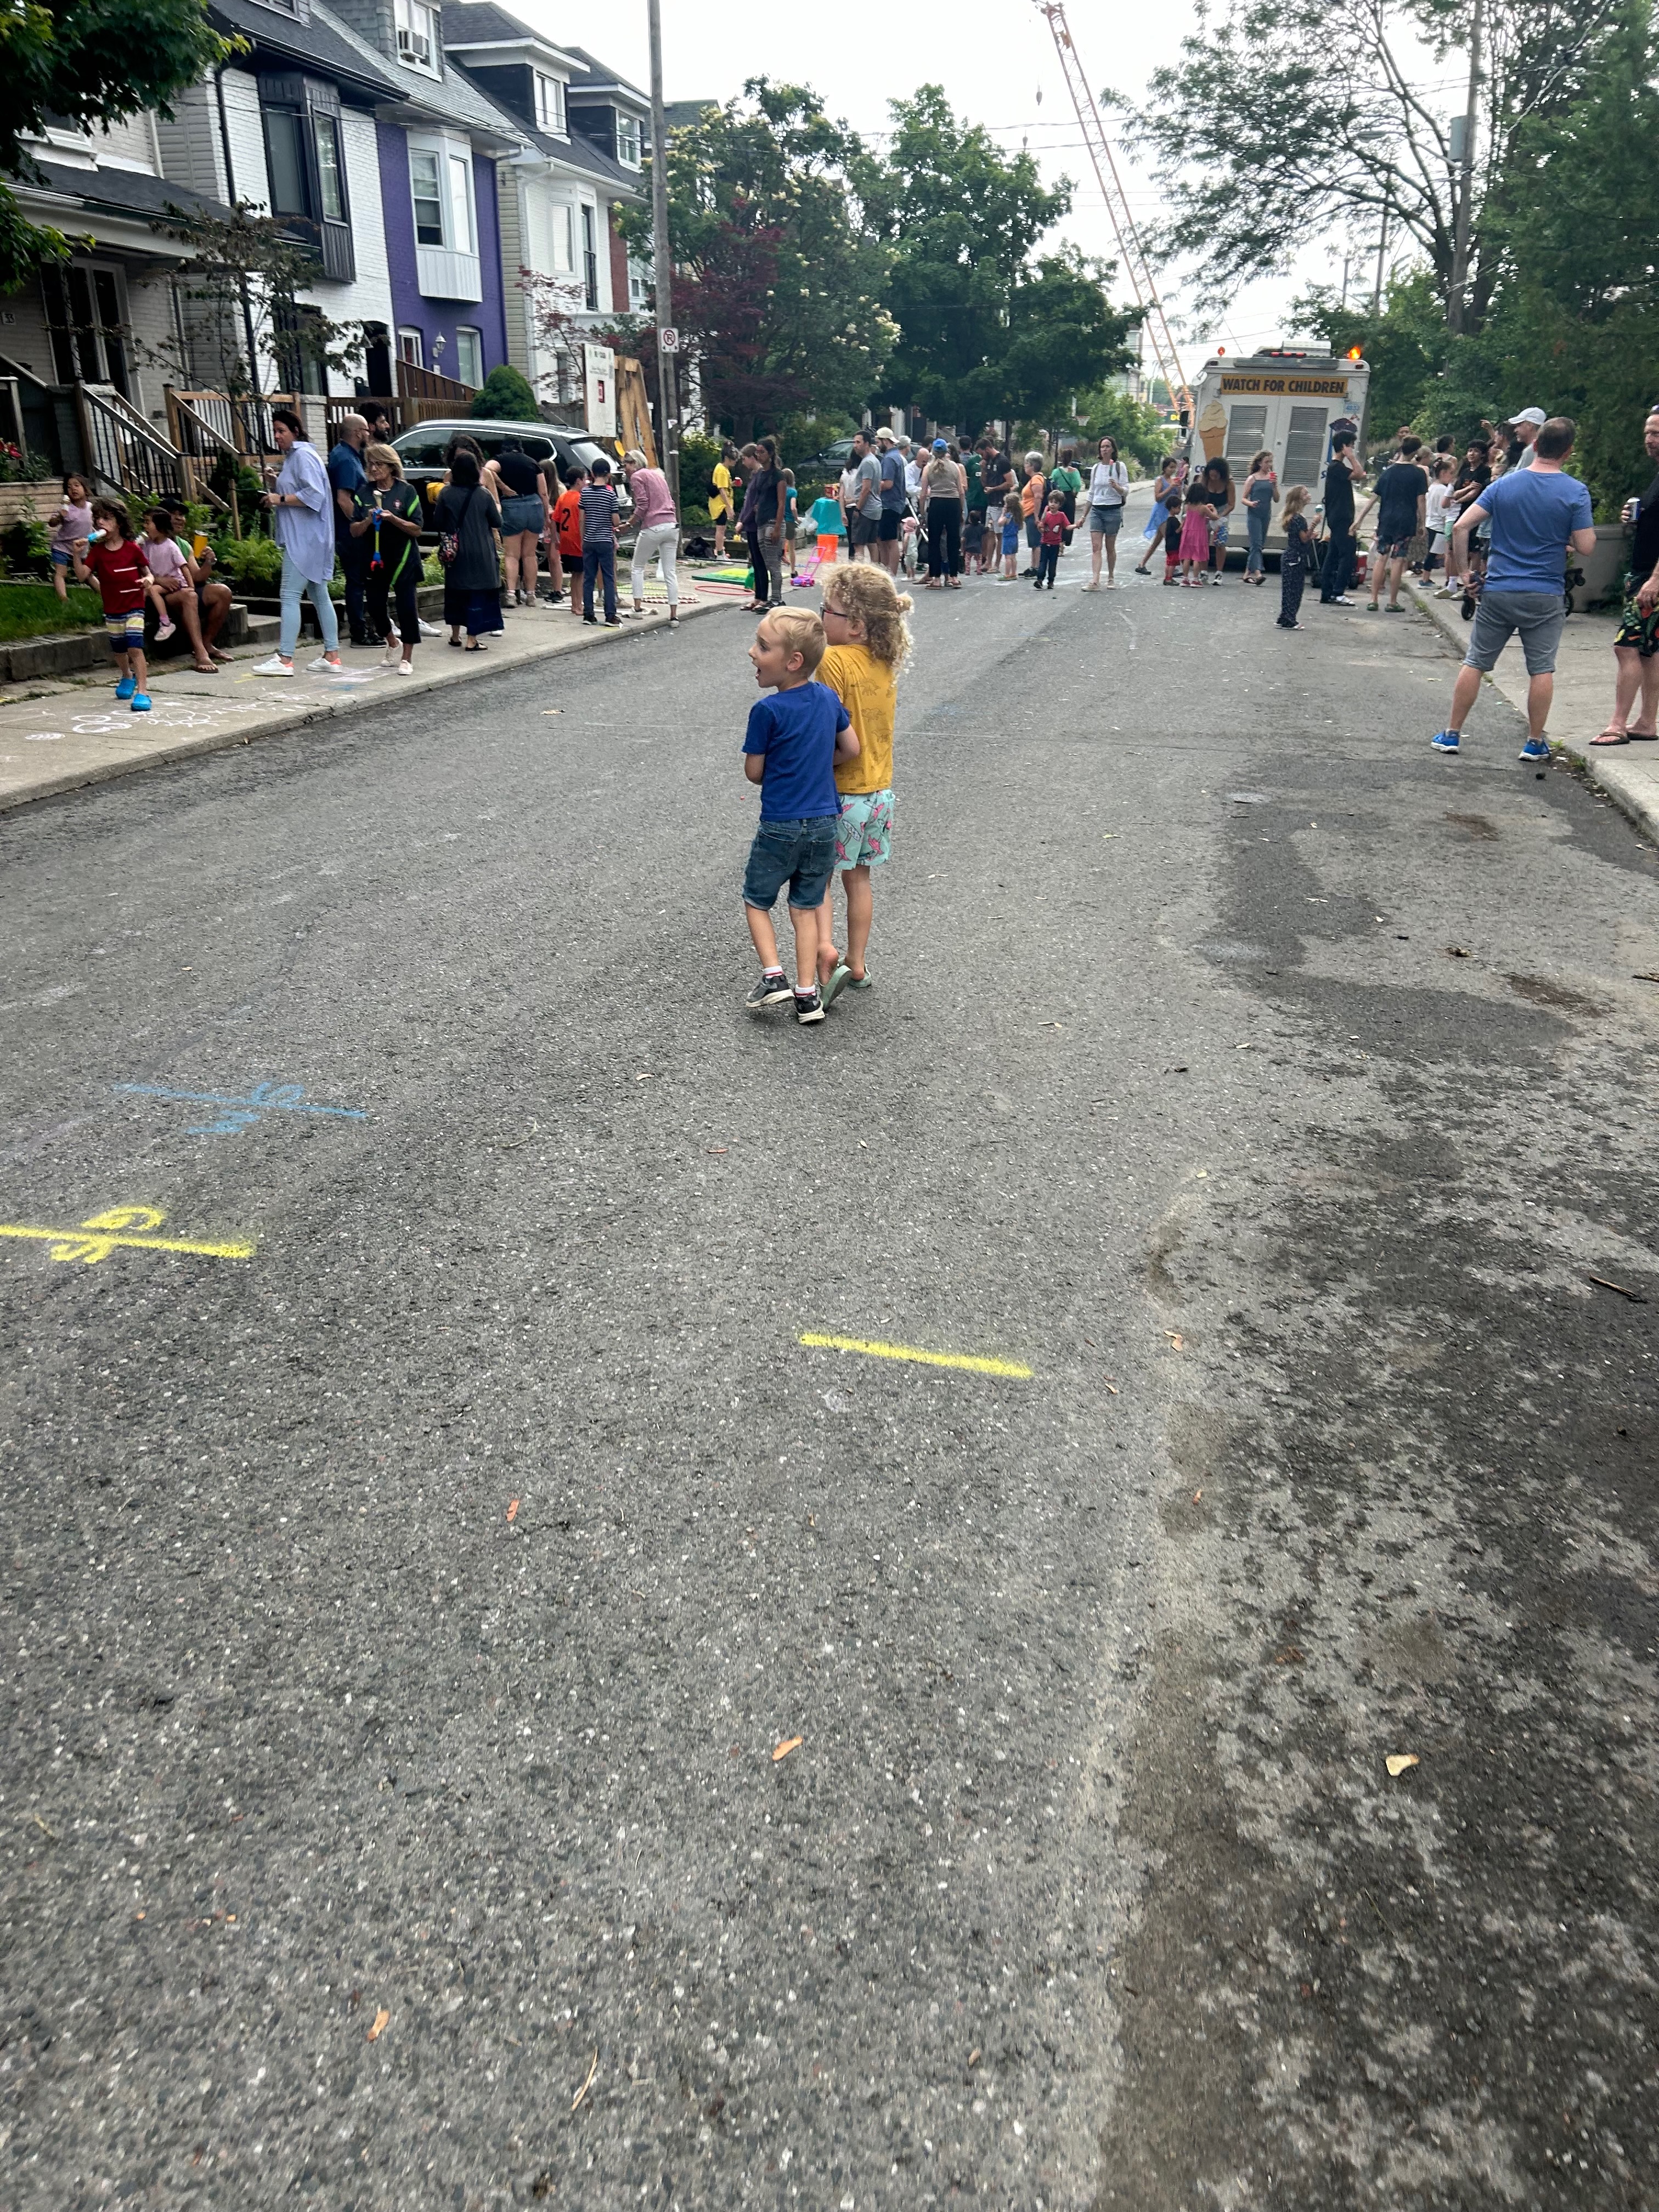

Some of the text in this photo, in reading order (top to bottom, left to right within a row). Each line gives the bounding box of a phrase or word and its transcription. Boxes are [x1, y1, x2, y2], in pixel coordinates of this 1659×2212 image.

[1223, 379, 1344, 393] WATCH FOR CHILDREN
[561, 508, 571, 532] 2
